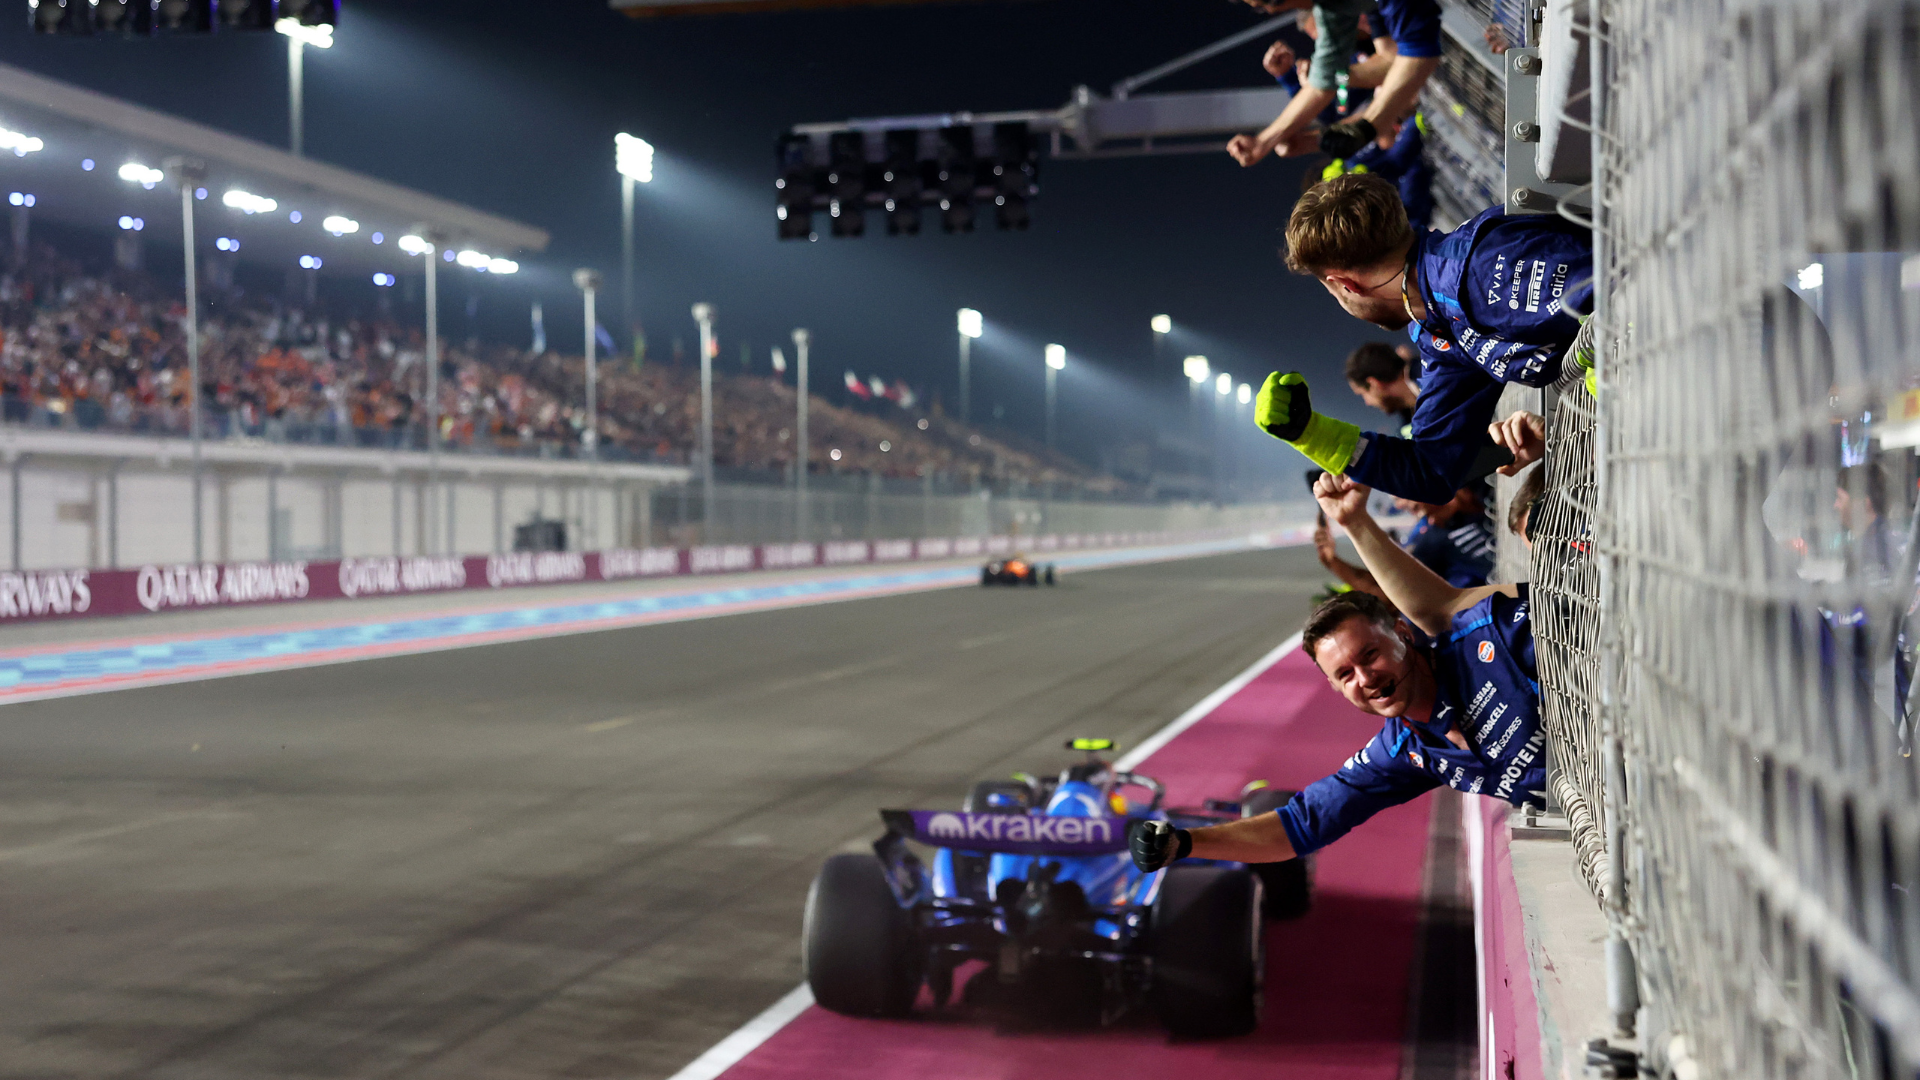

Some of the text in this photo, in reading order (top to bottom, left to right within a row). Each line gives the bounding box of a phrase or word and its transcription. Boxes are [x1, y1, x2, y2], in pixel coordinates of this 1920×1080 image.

[1493, 254, 1506, 288] VAST
[1511, 260, 1526, 299] KEEPER
[1525, 260, 1546, 312] PIRELLI
[1550, 263, 1568, 298] airia
[137, 560, 310, 612] QATAR AIRWAYS
[1475, 702, 1508, 744] DURACELL
[1499, 716, 1522, 747] SCORES
[1494, 729, 1546, 799] YPROTEIN
[967, 812, 1112, 844] kraken
